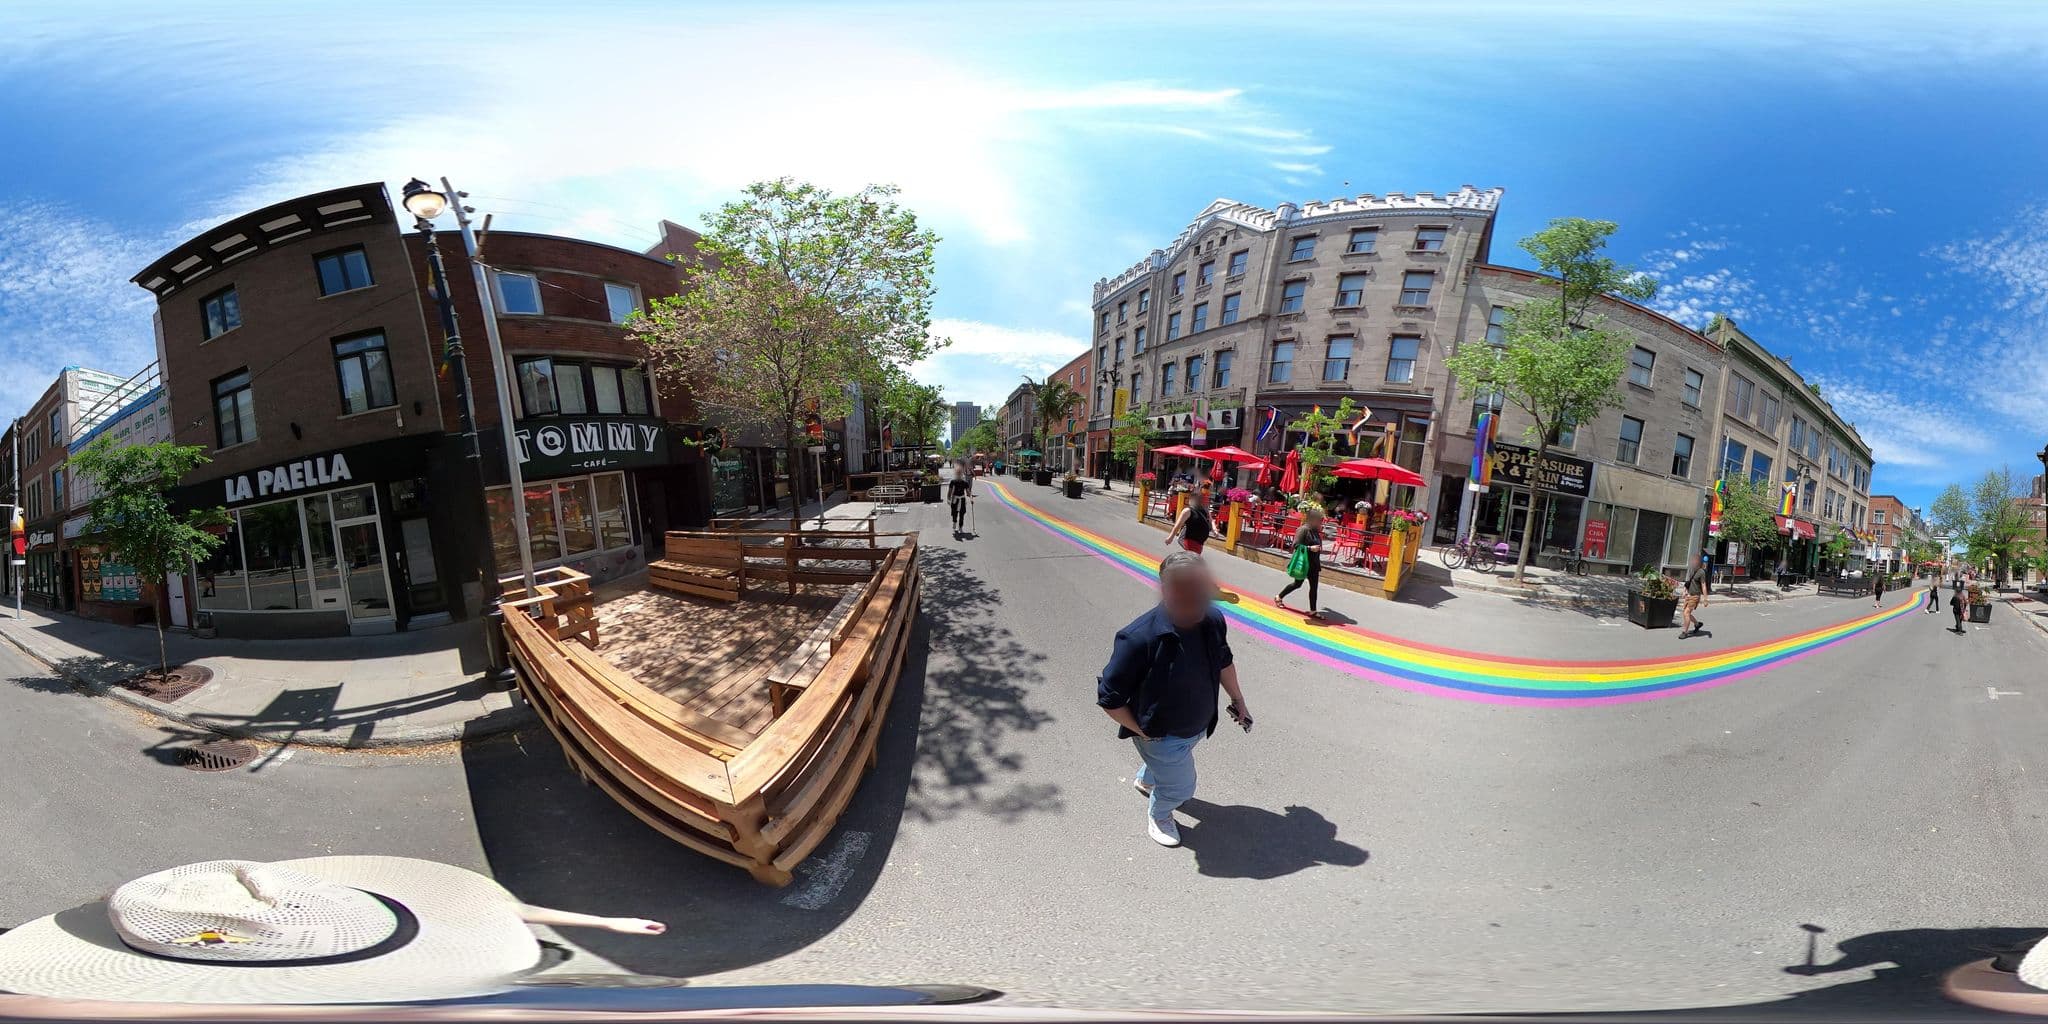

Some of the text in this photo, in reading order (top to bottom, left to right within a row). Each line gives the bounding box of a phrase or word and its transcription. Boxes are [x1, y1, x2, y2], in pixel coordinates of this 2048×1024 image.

[514, 422, 659, 464] TOMMY
[583, 457, 606, 468] CAFÉ
[1510, 453, 1584, 477] PLEASURE
[225, 453, 352, 503] LA PAELLA
[1509, 465, 1560, 485] & PAIN
